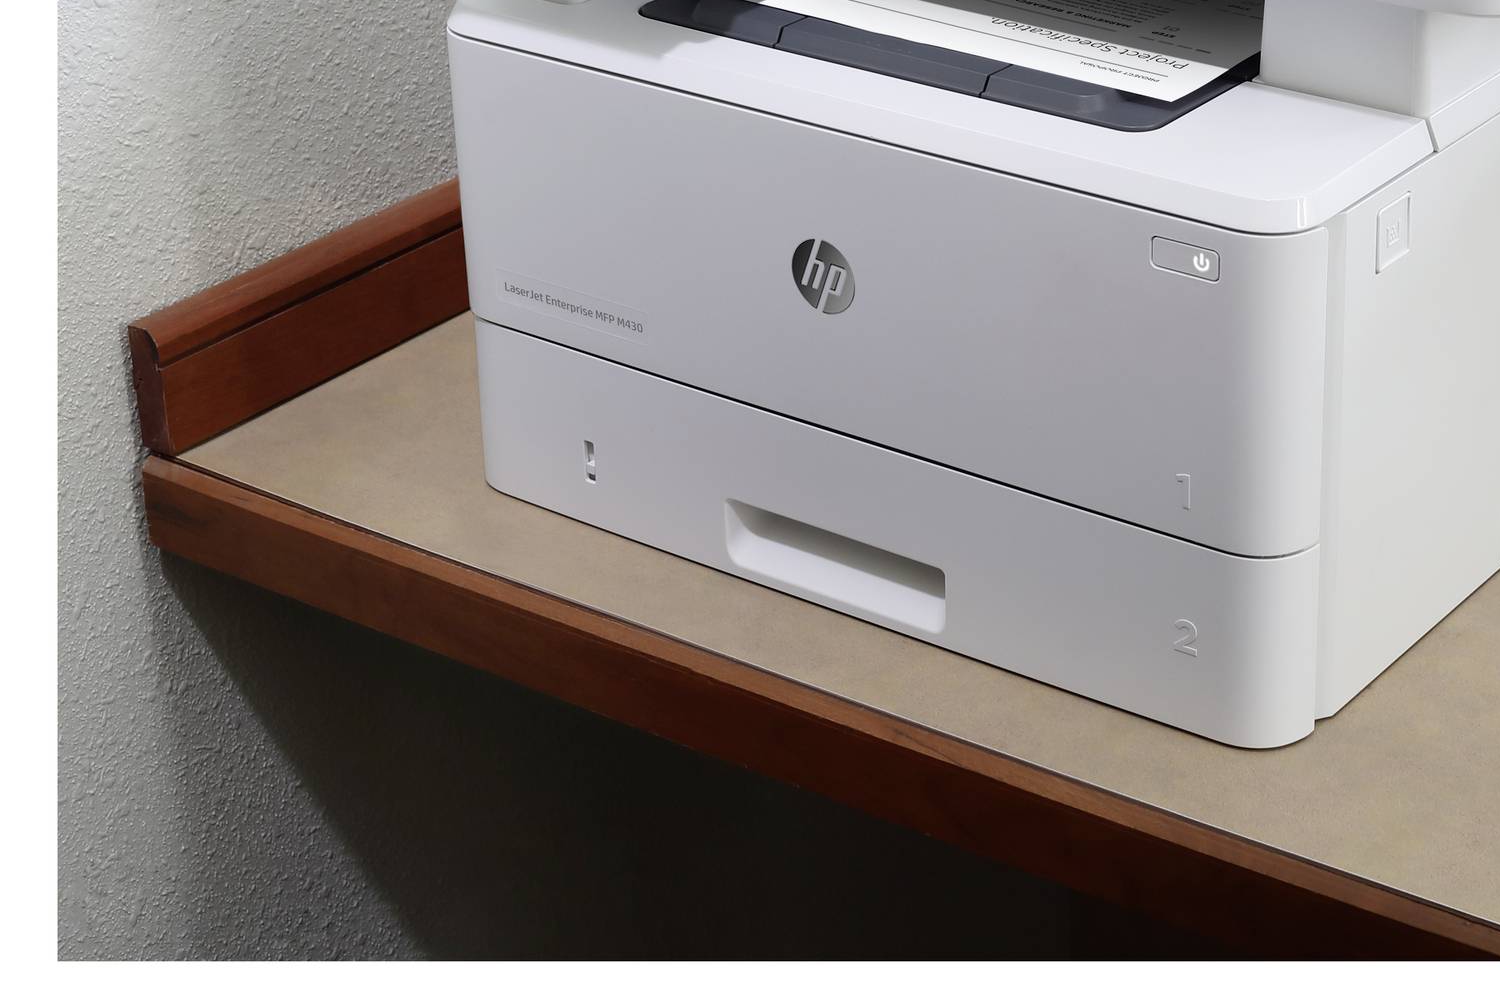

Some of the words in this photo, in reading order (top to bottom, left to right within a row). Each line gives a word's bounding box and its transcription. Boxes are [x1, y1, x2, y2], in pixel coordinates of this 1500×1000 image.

[990, 16, 1118, 54] Specification.
[1119, 47, 1190, 70] Project
[793, 238, 855, 315] hp
[504, 282, 544, 303] LaserJet
[545, 294, 594, 318] Enterprise
[595, 309, 615, 324] MFP
[616, 316, 644, 334] M430
[1172, 618, 1199, 657] 2
